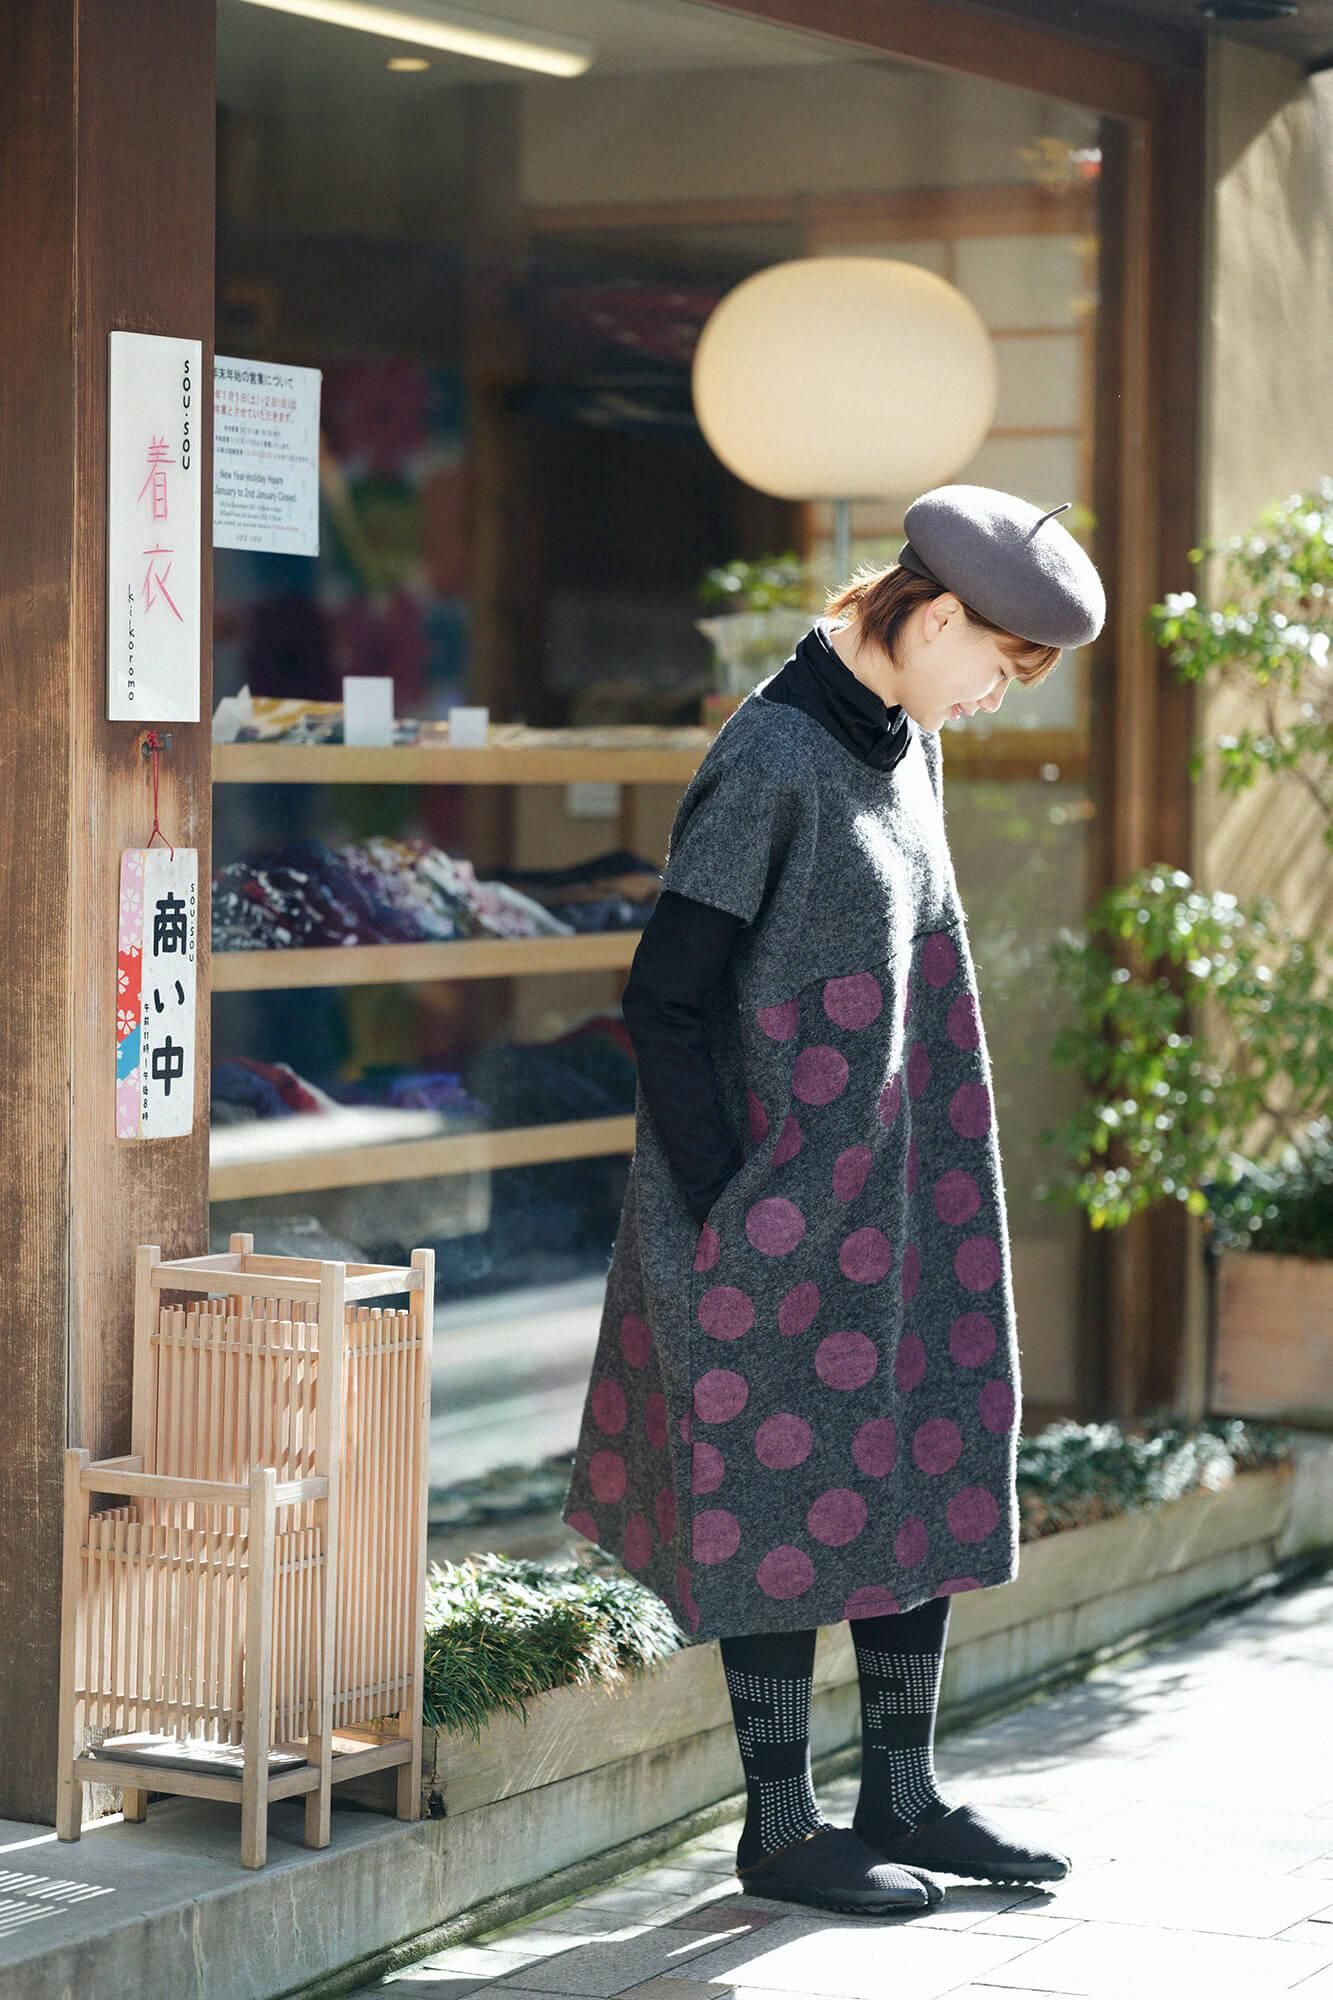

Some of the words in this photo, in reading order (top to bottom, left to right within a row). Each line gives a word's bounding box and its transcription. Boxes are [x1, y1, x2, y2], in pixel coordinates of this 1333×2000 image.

[137, 434, 184, 623] 着衣
[220, 469, 231, 480] New
[233, 471, 245, 481] Year
[127, 584, 135, 701] kikoromo
[152, 891, 188, 1097] 商い中
